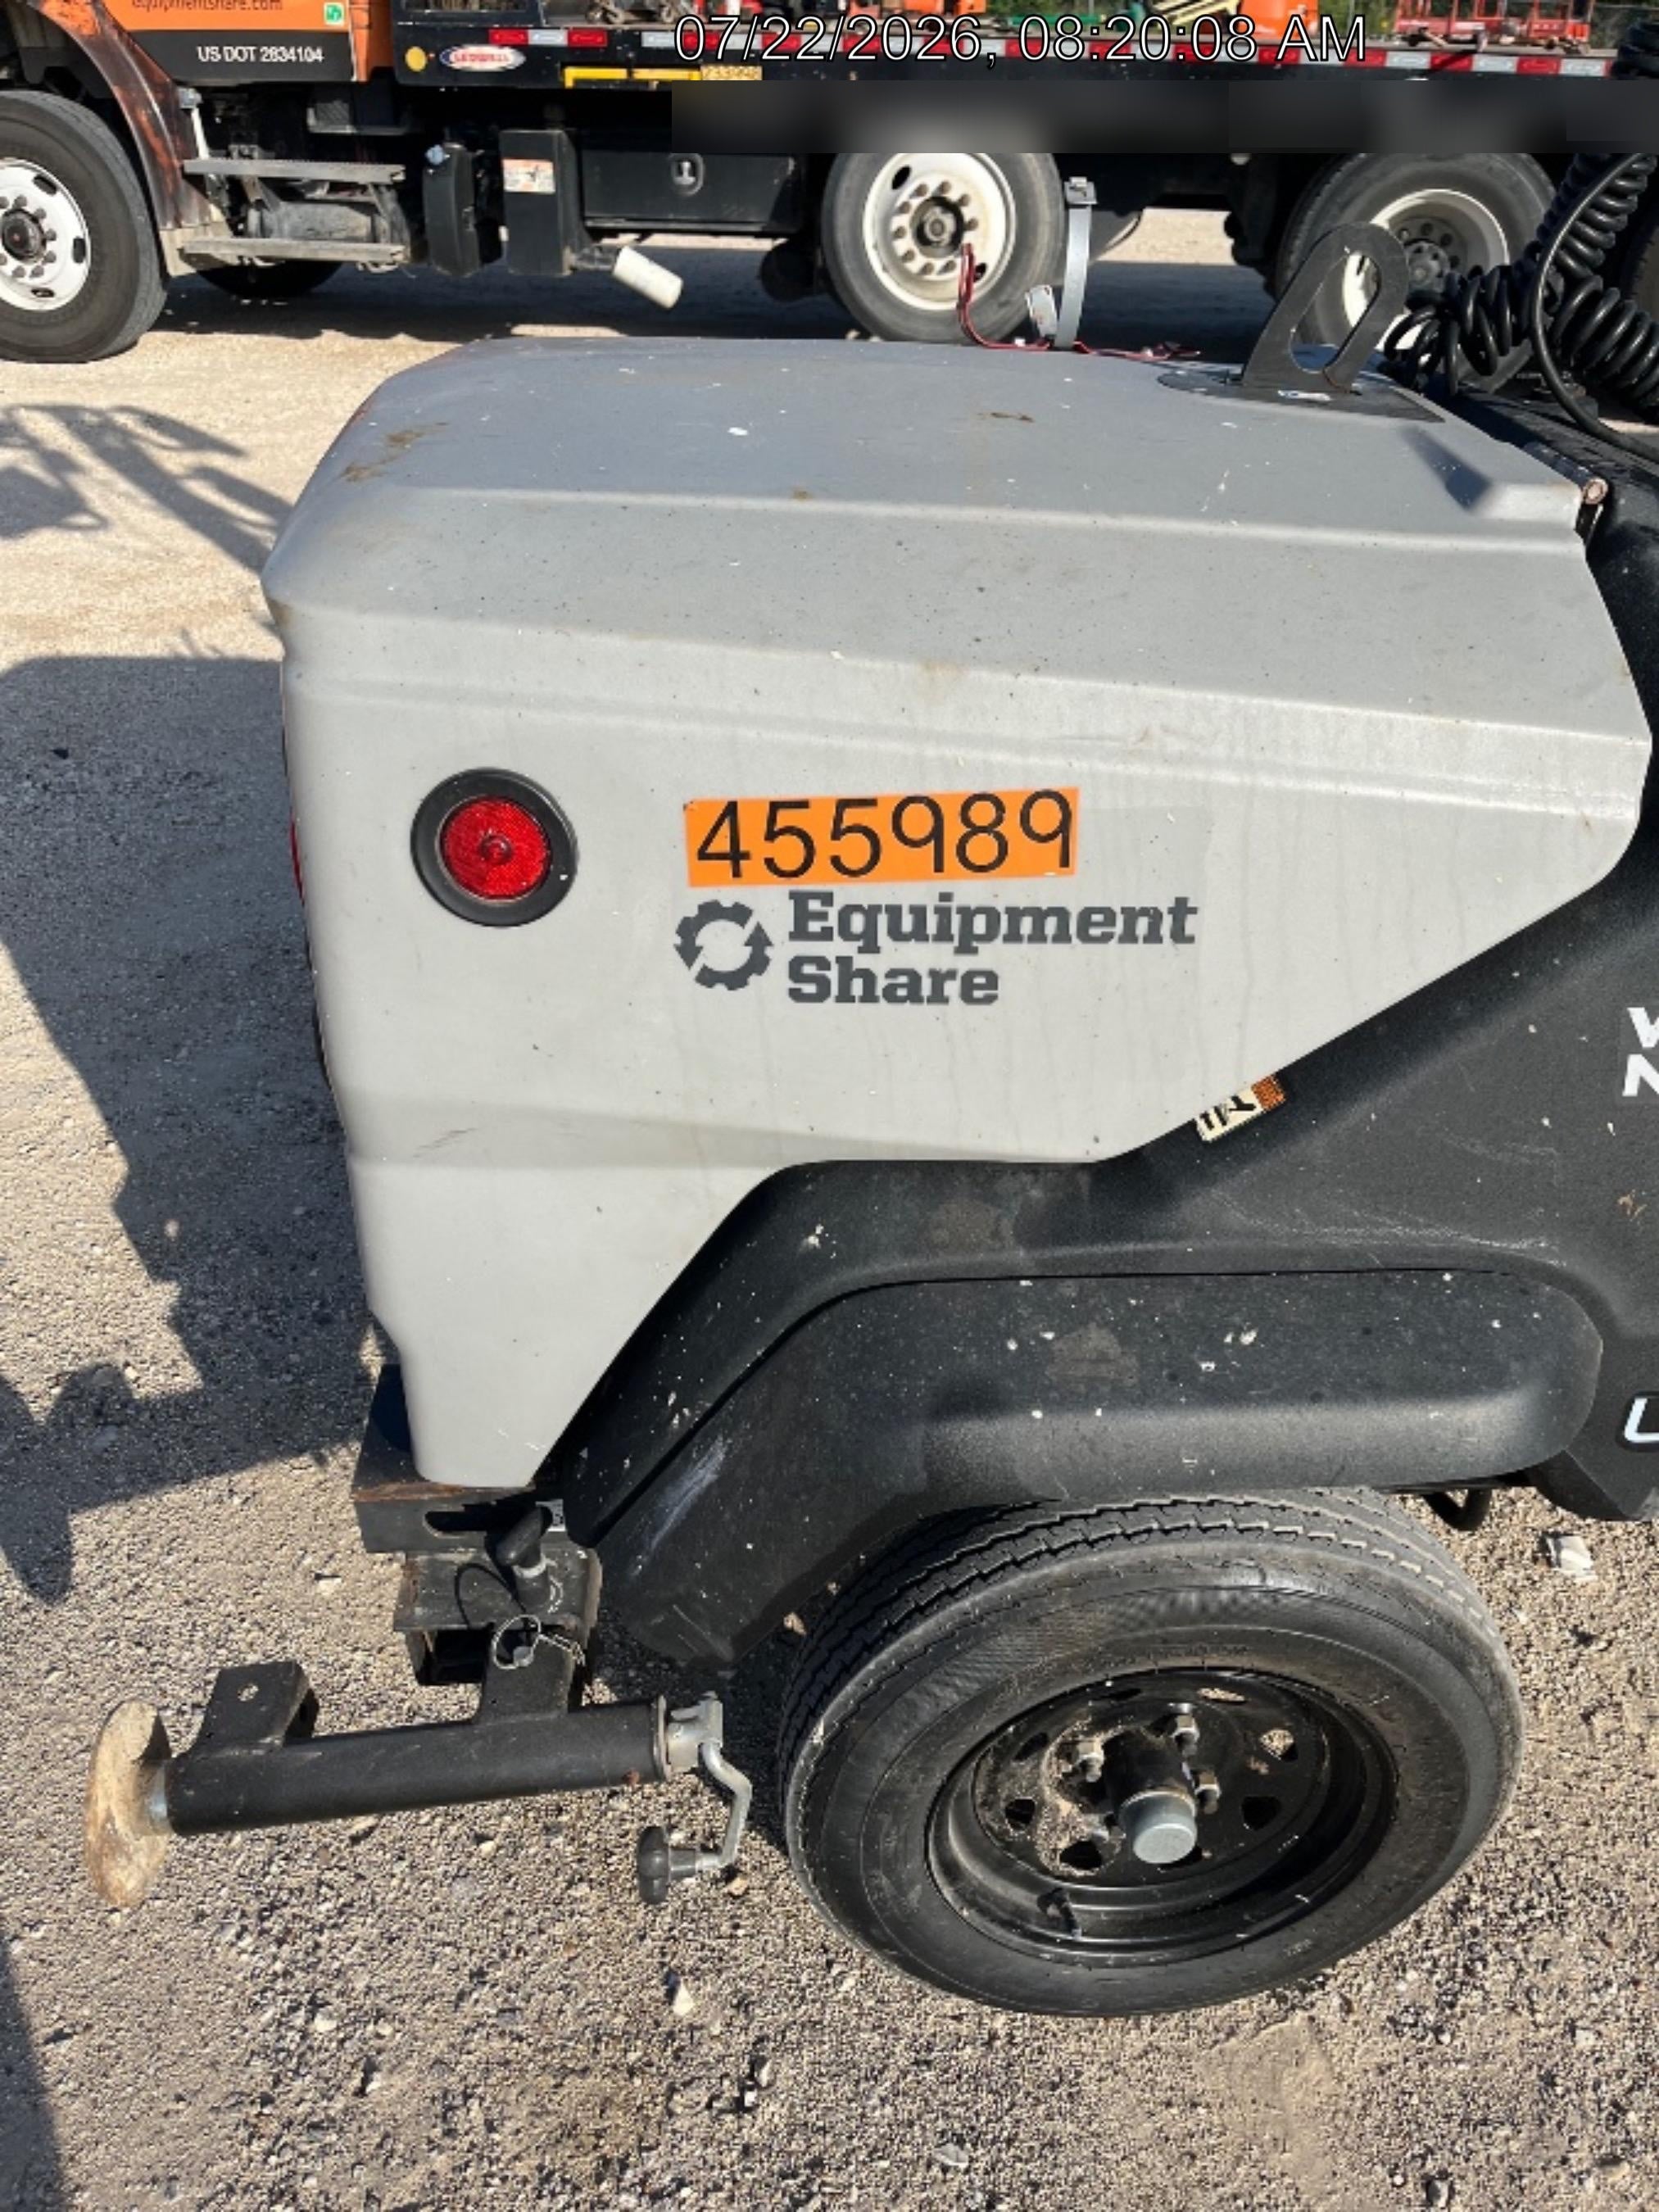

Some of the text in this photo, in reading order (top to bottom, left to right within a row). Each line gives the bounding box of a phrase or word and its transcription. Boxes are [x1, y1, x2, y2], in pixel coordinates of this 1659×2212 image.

[197, 46, 220, 62] US
[223, 46, 257, 62] DOT
[696, 789, 1072, 879] 455989
[788, 891, 1199, 954] Equipment
[787, 955, 999, 1004] Share
